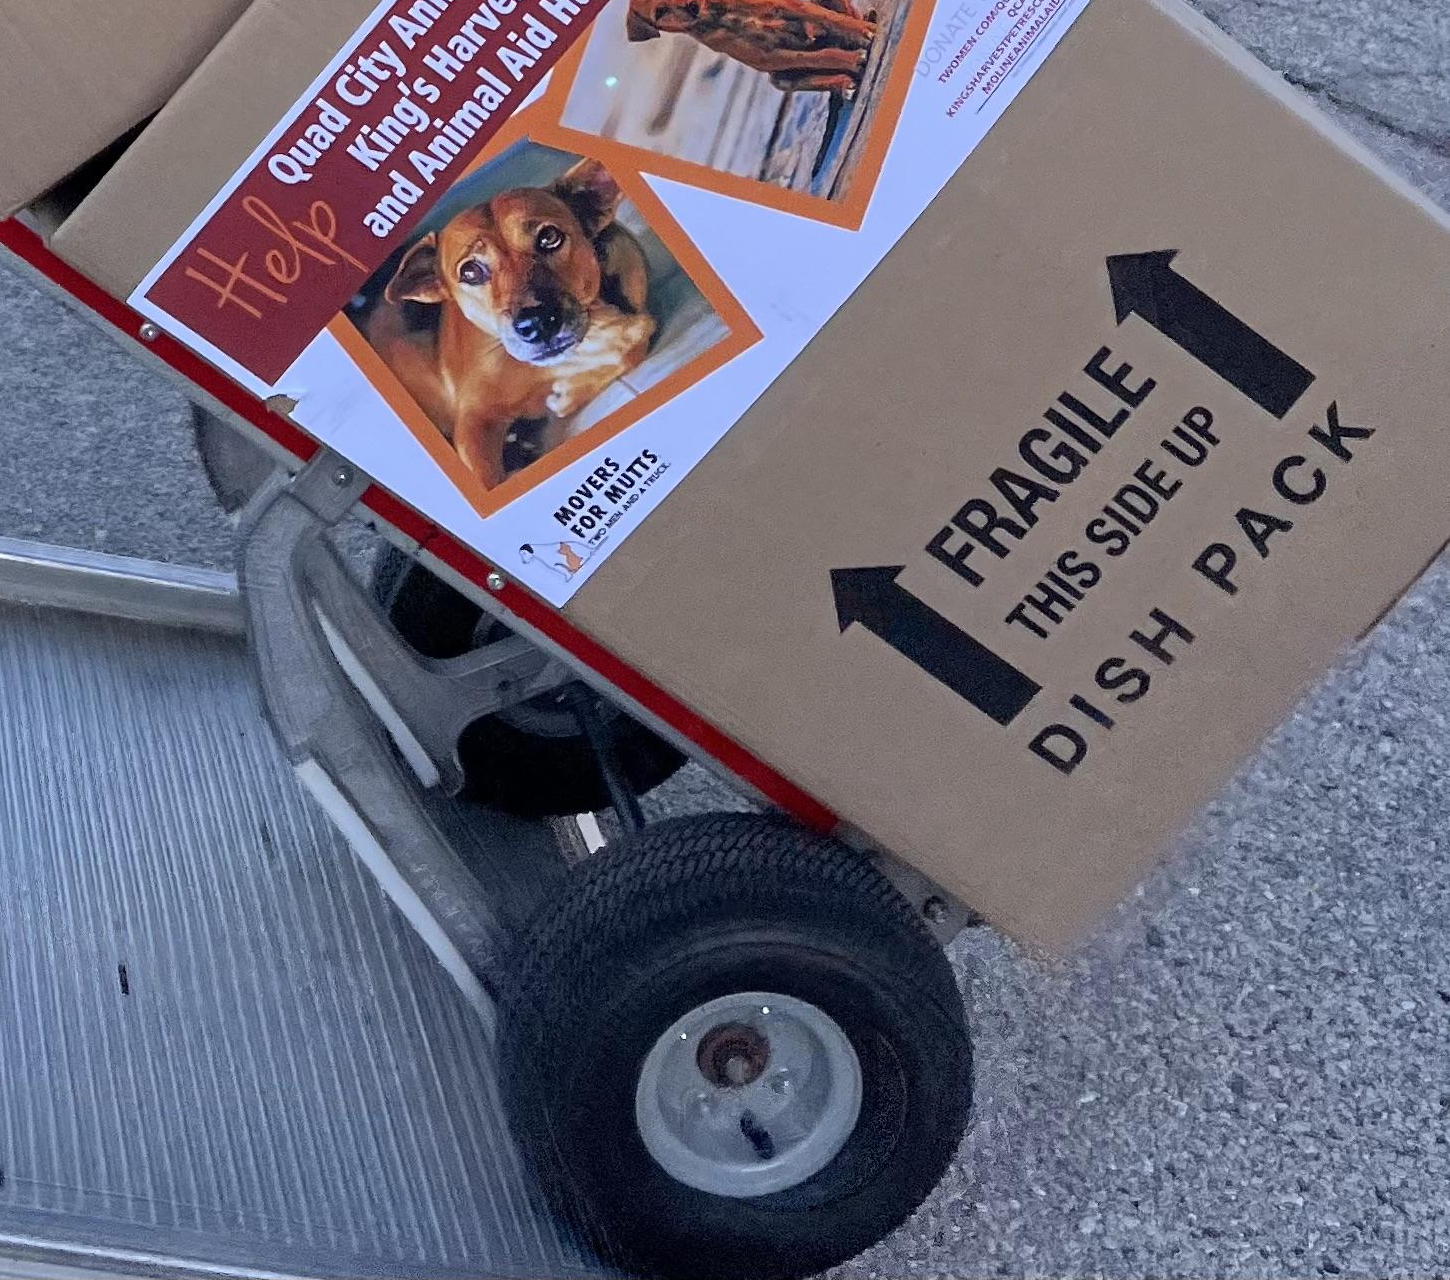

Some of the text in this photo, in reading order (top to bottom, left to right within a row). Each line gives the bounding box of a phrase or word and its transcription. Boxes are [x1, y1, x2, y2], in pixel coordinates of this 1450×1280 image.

[916, 1, 976, 79] DONATE
[267, 97, 352, 184] Quad
[335, 40, 407, 106] City
[346, 76, 441, 171] King's
[362, 169, 425, 238] and
[408, 66, 512, 185] Animal
[496, 12, 558, 82] Aid
[183, 193, 369, 319] Help
[553, 456, 620, 527] MOVERS
[569, 448, 658, 539] FOR MUTTS
[588, 527, 607, 545] TWO
[604, 510, 624, 529] MEN
[622, 493, 640, 512] AND
[924, 345, 1158, 588] FRAGILE
[1004, 405, 1221, 640] THIS SIDE UP
[1027, 399, 1376, 776] DISH PACK
